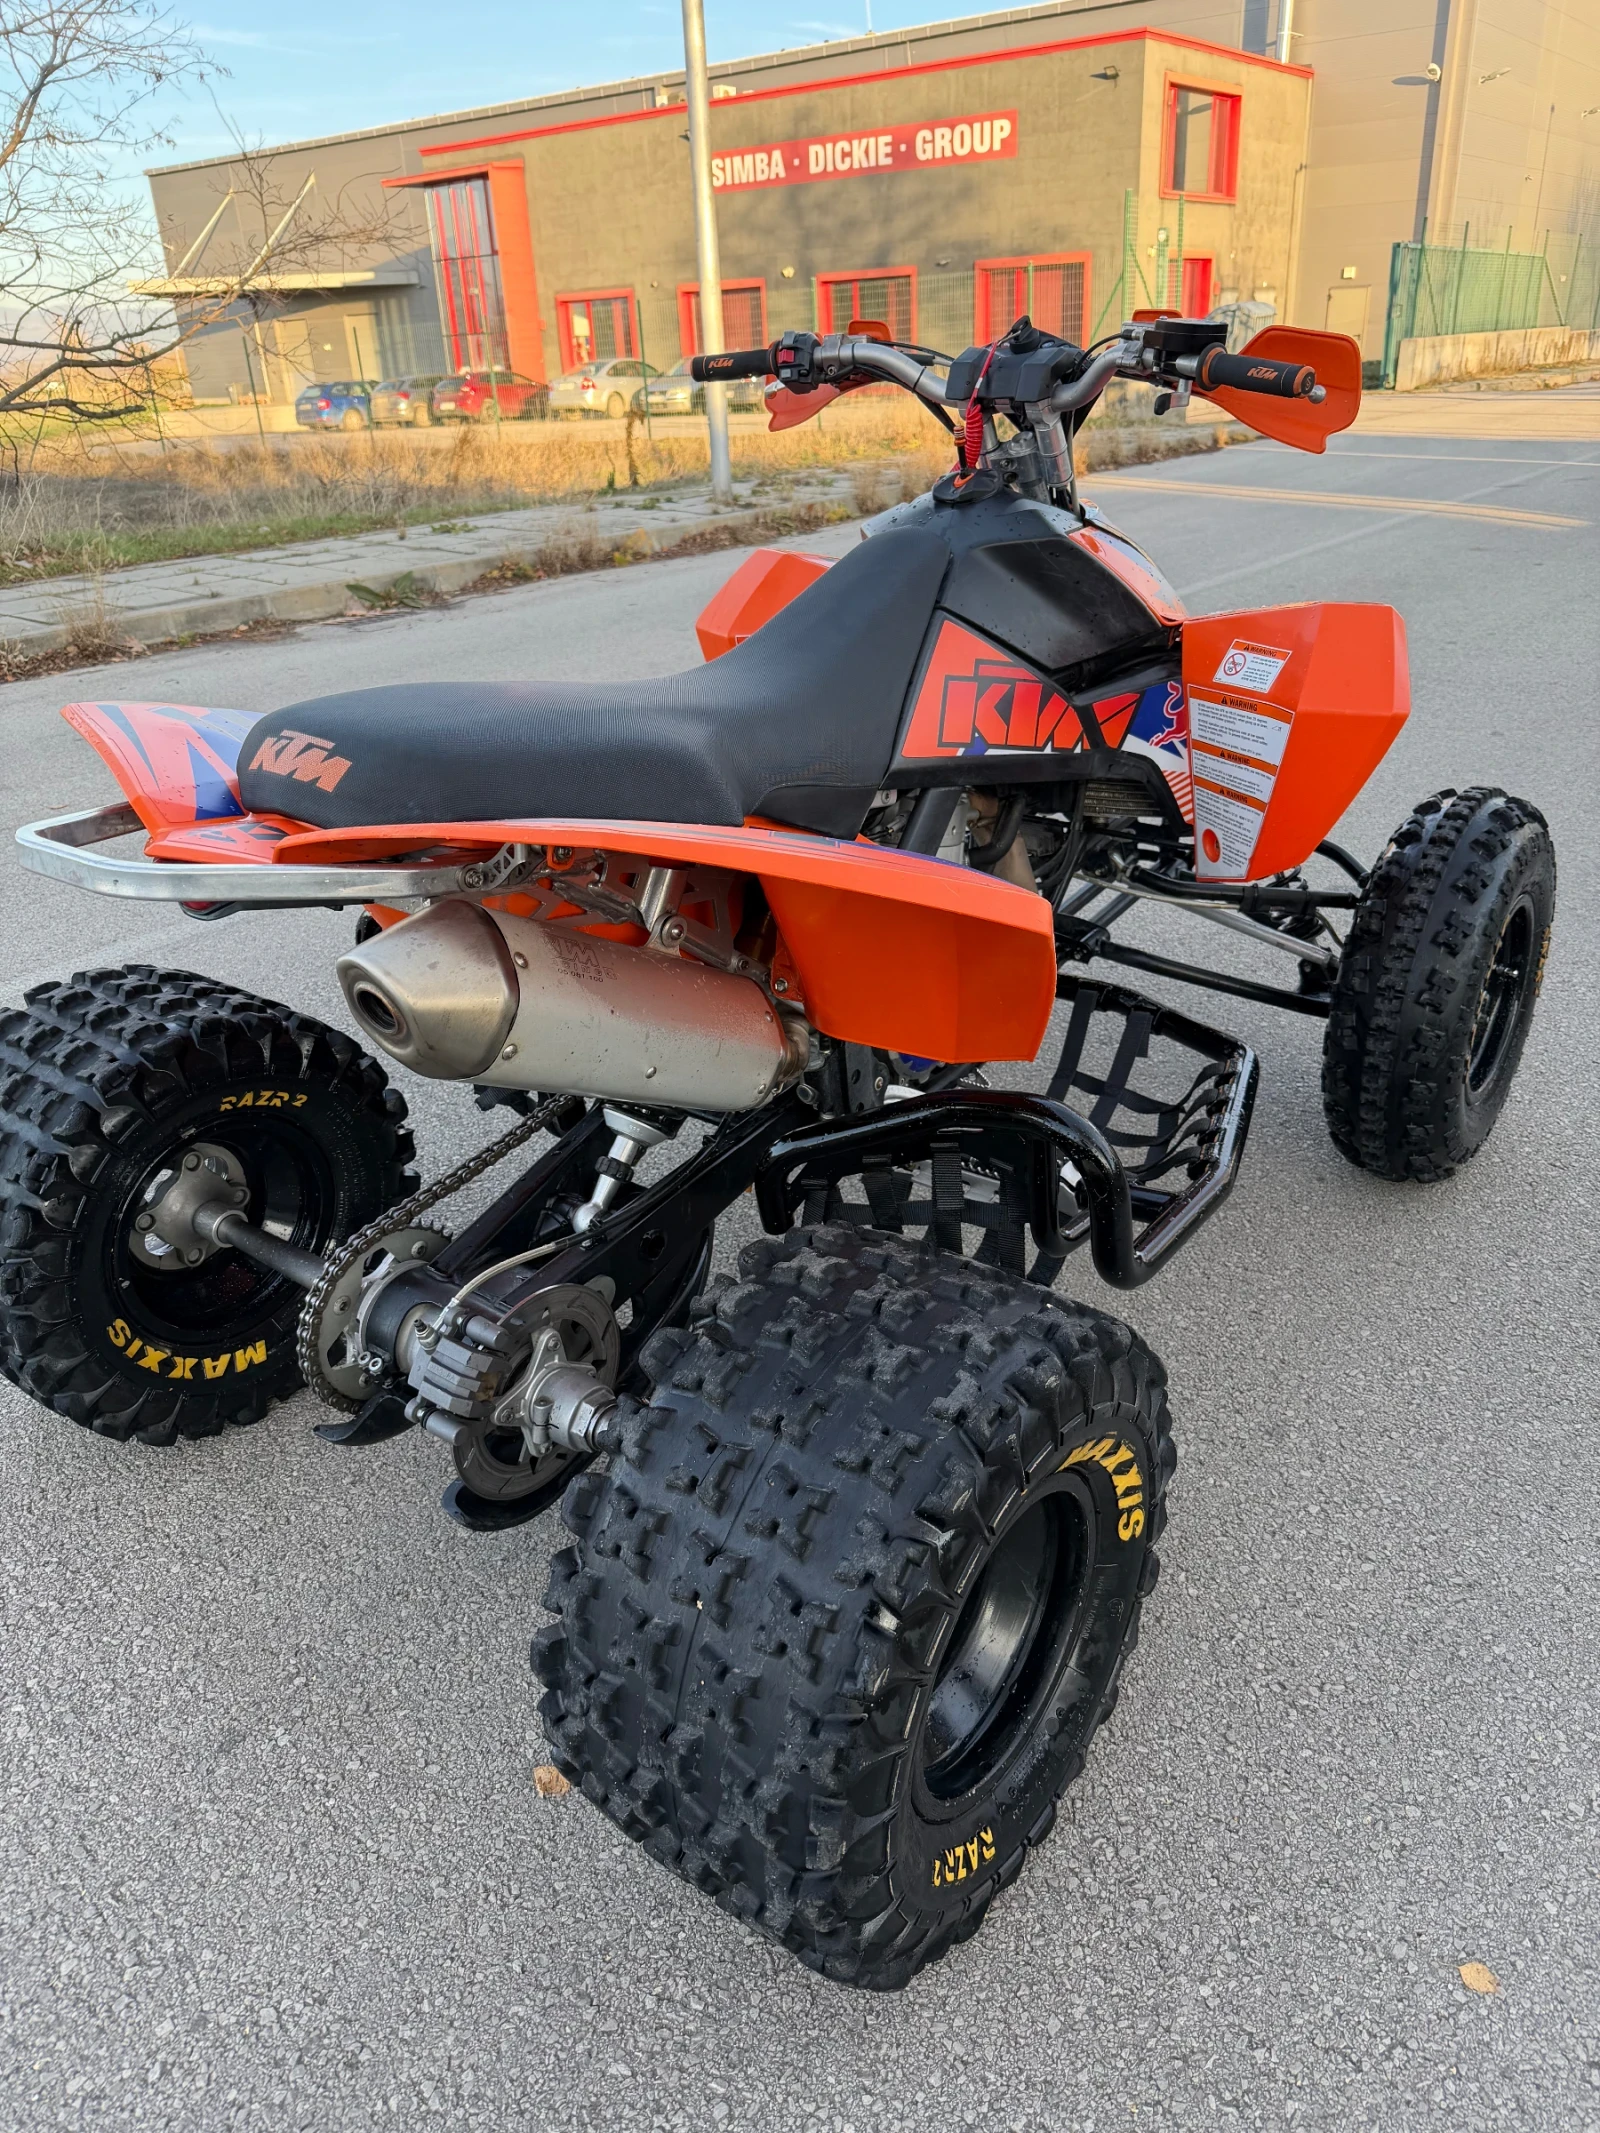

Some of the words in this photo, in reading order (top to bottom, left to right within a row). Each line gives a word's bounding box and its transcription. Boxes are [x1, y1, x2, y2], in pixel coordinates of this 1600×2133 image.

[711, 150, 786, 187] SIMBA
[808, 135, 893, 174] DICKIE
[915, 118, 1011, 161] GROUP
[708, 357, 734, 369] KTM
[1246, 366, 1278, 380] KTM
[1250, 646, 1277, 657] WARNING
[938, 660, 1142, 749] KTM
[1229, 696, 1258, 711] WARNING
[248, 729, 352, 793] KTM
[1227, 753, 1250, 765] WARNING
[1226, 790, 1248, 803] WARNING
[106, 1318, 268, 1380] MAXXIS
[1055, 1436, 1145, 1542] MAXXIS
